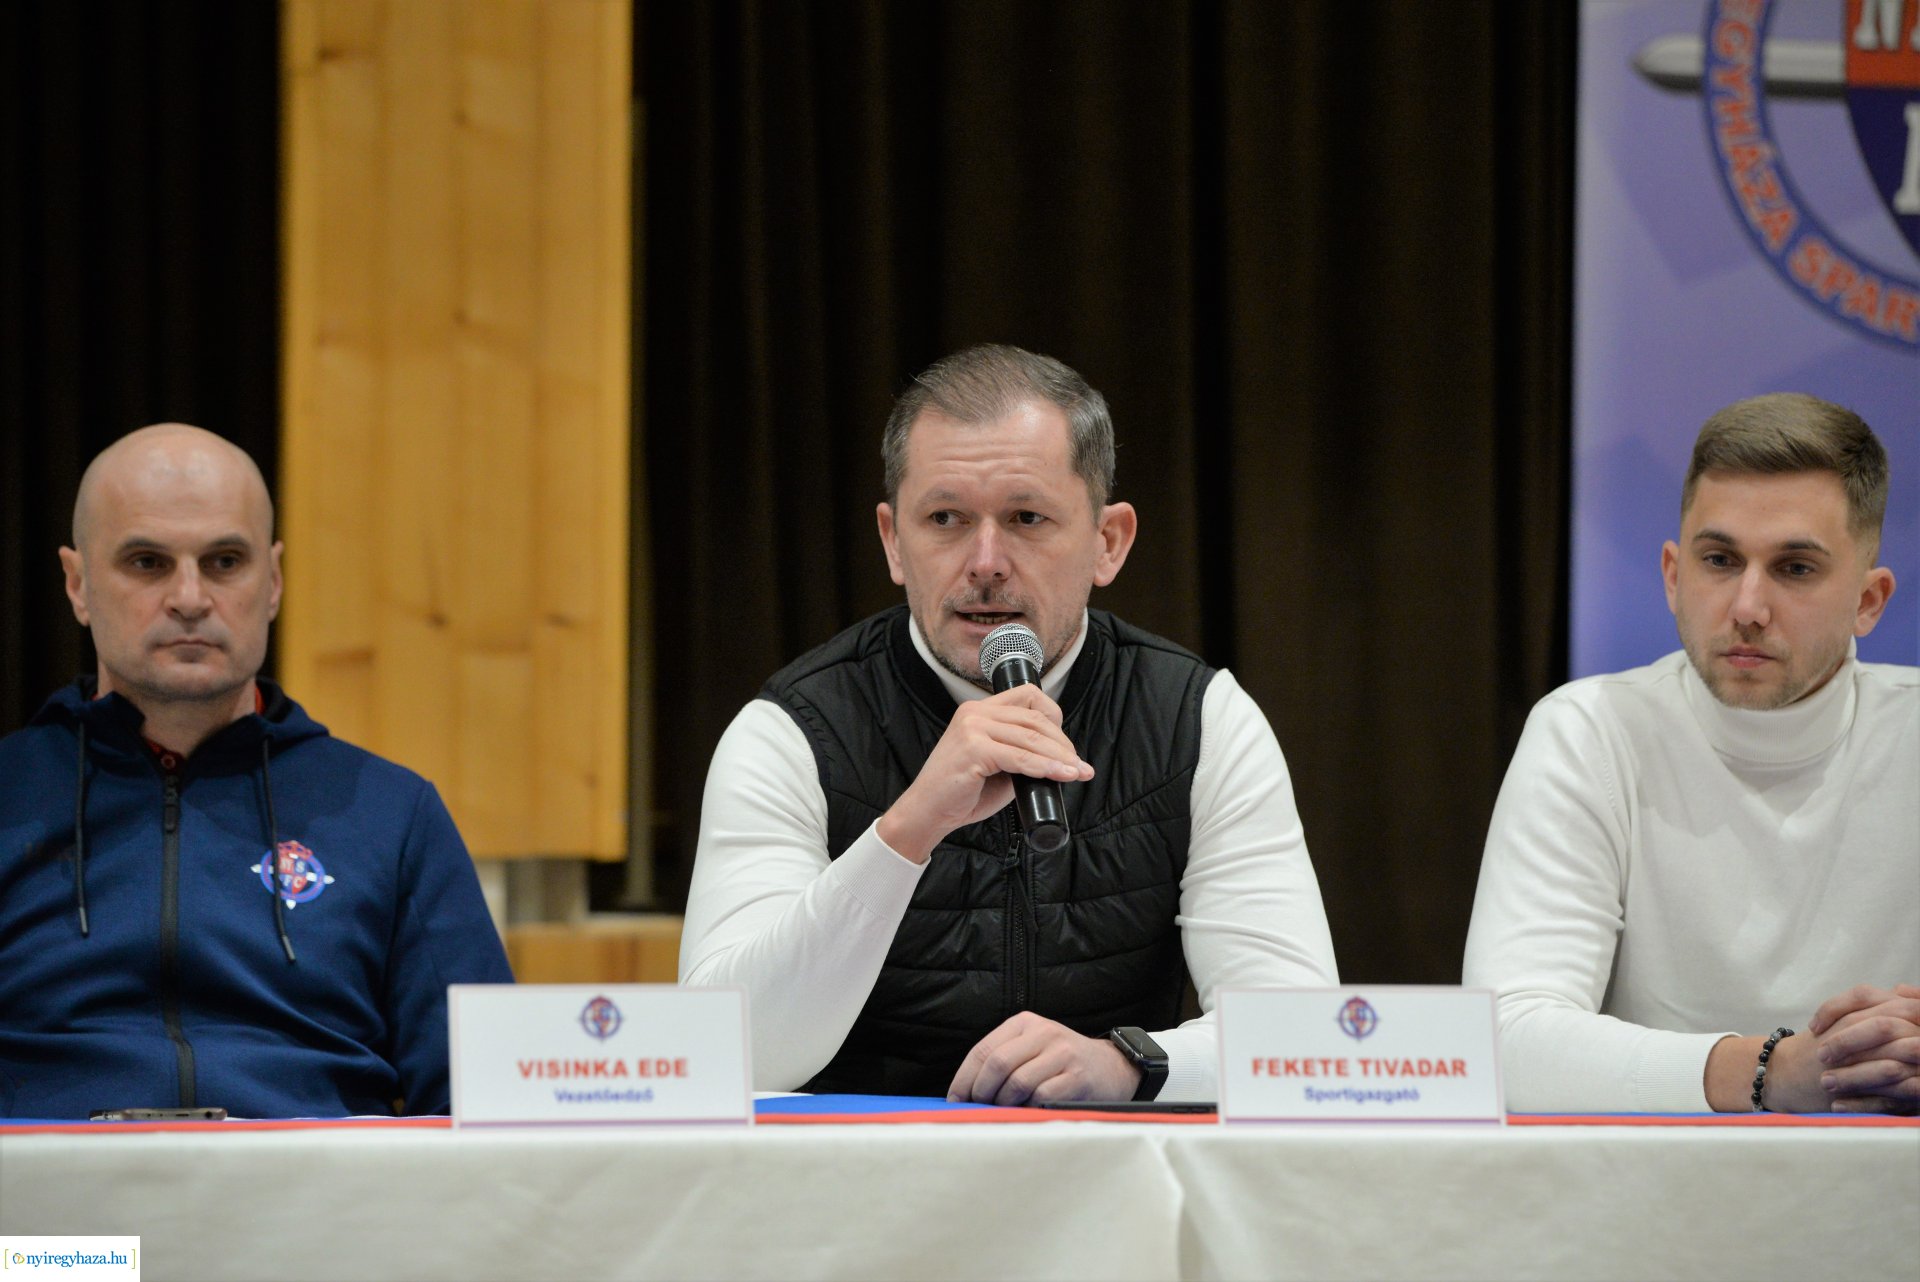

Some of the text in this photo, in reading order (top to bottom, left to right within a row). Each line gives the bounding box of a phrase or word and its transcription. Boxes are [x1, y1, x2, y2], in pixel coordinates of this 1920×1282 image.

[517, 1058, 688, 1079] VISINKA EDE
[1251, 1058, 1468, 1077] FEKETE TIVADAR
